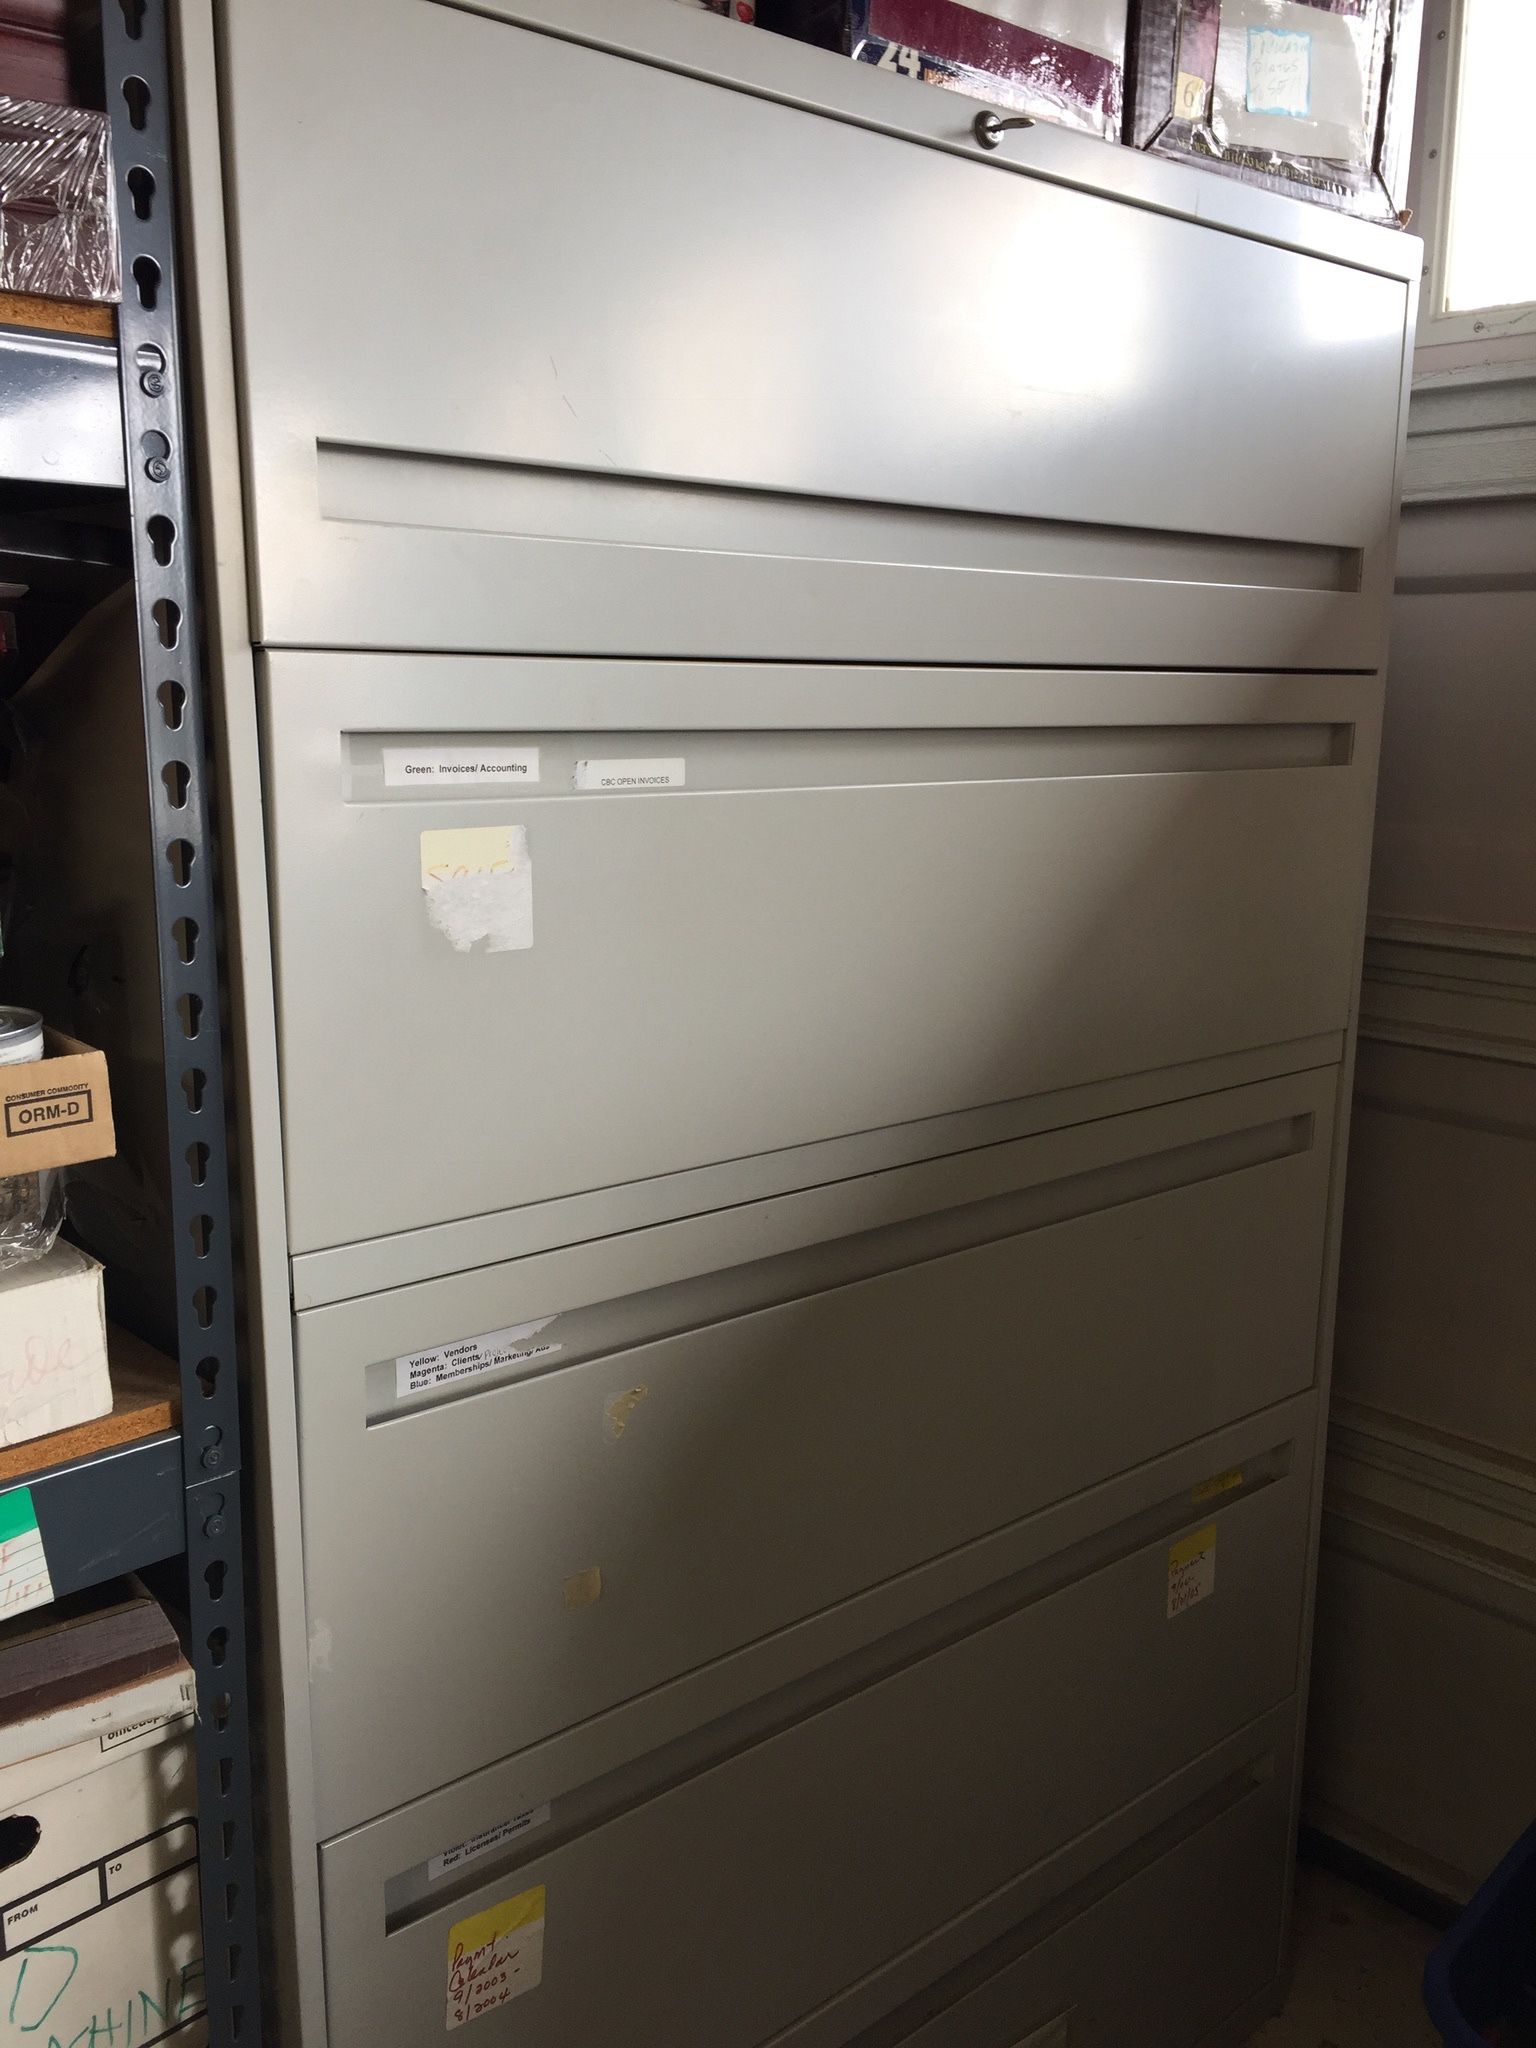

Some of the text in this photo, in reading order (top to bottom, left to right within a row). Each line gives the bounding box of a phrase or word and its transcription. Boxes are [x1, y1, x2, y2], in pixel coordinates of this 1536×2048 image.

[405, 763, 528, 775] Green: Invoices/ Accounting
[601, 776, 670, 786] CBC OPEN INVOICES
[5, 1083, 89, 1102] CONSUMER COMMODITY
[18, 1101, 79, 1124] ORM-D
[409, 1344, 478, 1368] Yellow: Vendors
[410, 1363, 447, 1379] Magenta:
[451, 1353, 483, 1367] Clients/
[410, 1378, 432, 1390] Blue:
[435, 1360, 493, 1382] Memberships/
[443, 1818, 531, 1867] Red: Licenses/ Permits
[108, 1863, 122, 1875] TO
[7, 1903, 39, 1926] FROM
[454, 1987, 511, 2022] 8/2004
